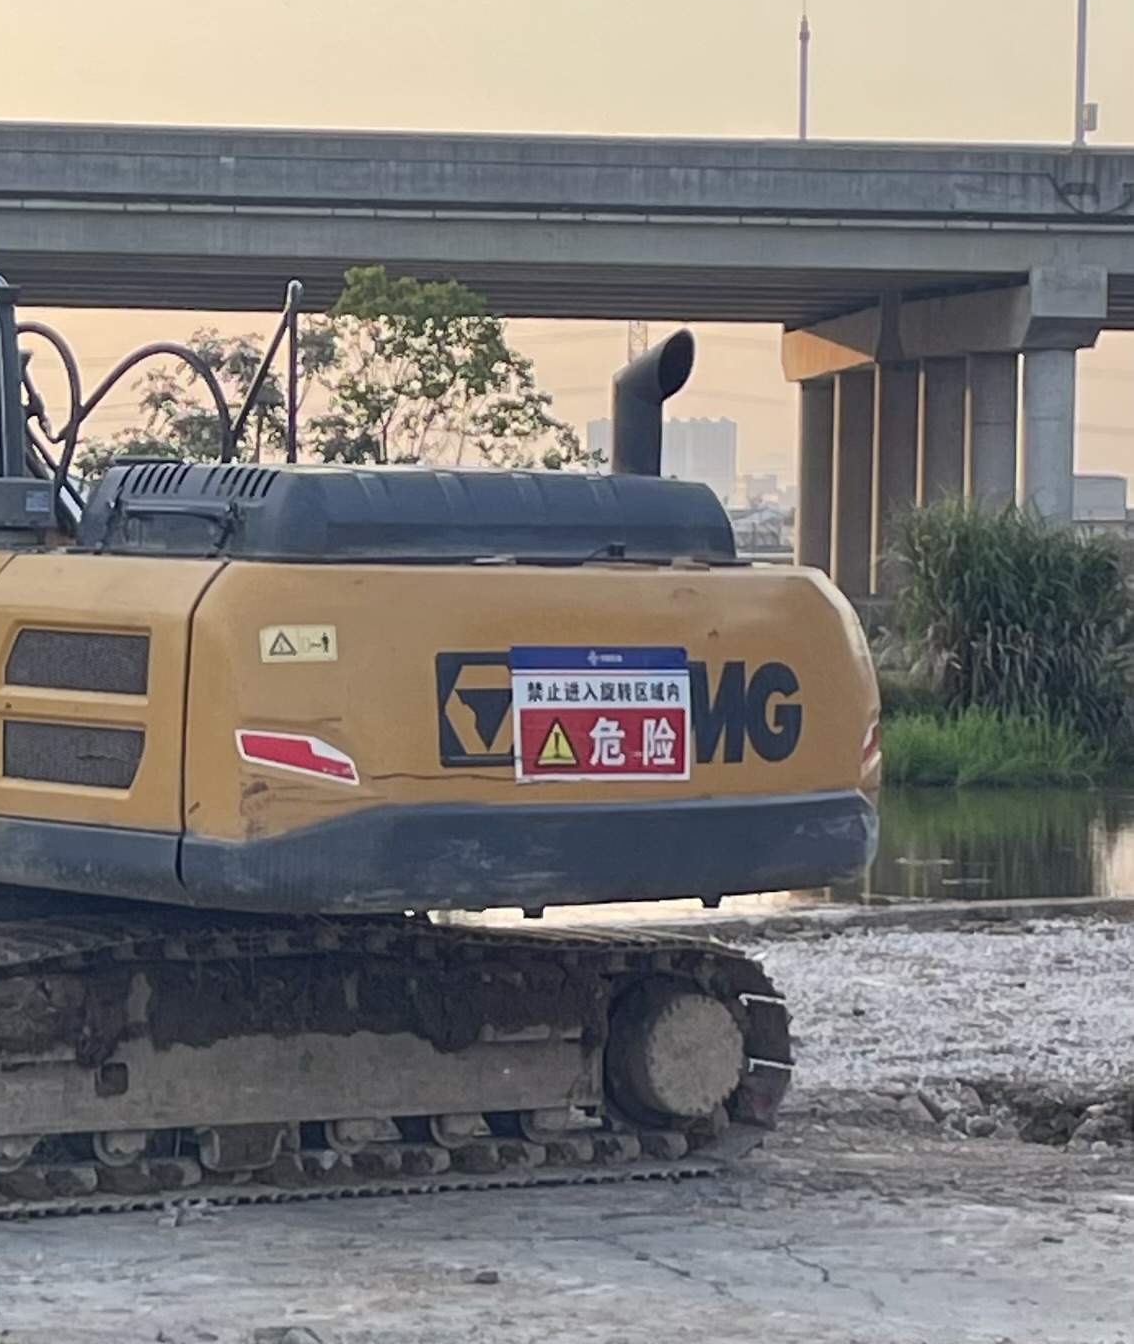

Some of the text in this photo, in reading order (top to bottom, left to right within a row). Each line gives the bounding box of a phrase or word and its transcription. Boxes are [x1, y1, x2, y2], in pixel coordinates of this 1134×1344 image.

[527, 681, 680, 703] 禁止进入旋转区域内
[688, 660, 803, 764] MG
[589, 716, 677, 766] 危险
